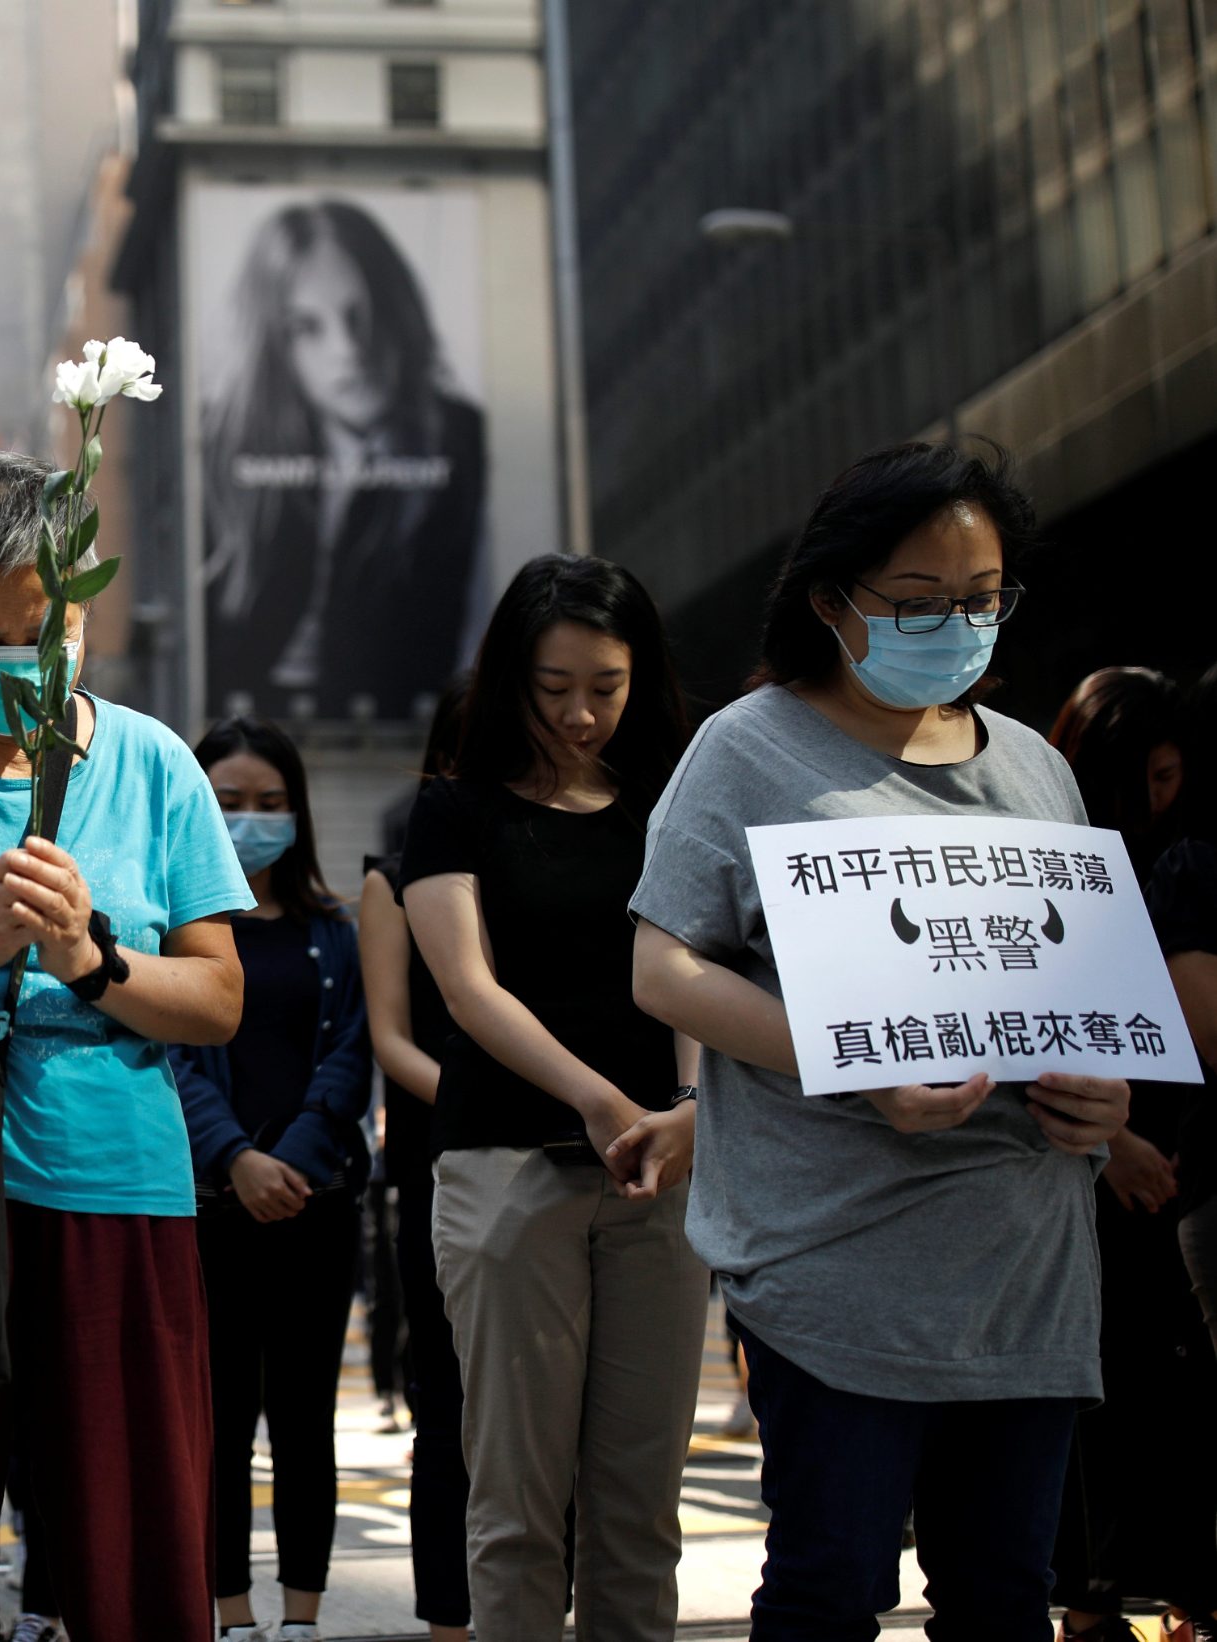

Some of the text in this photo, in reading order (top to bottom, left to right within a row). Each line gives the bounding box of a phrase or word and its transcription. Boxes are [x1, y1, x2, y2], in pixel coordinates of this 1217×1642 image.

[786, 845, 1115, 896] 和平市民坦蕩蕩
[924, 914, 1042, 973] 黑警
[826, 1010, 1167, 1069] 真槍亂棍來奪命
